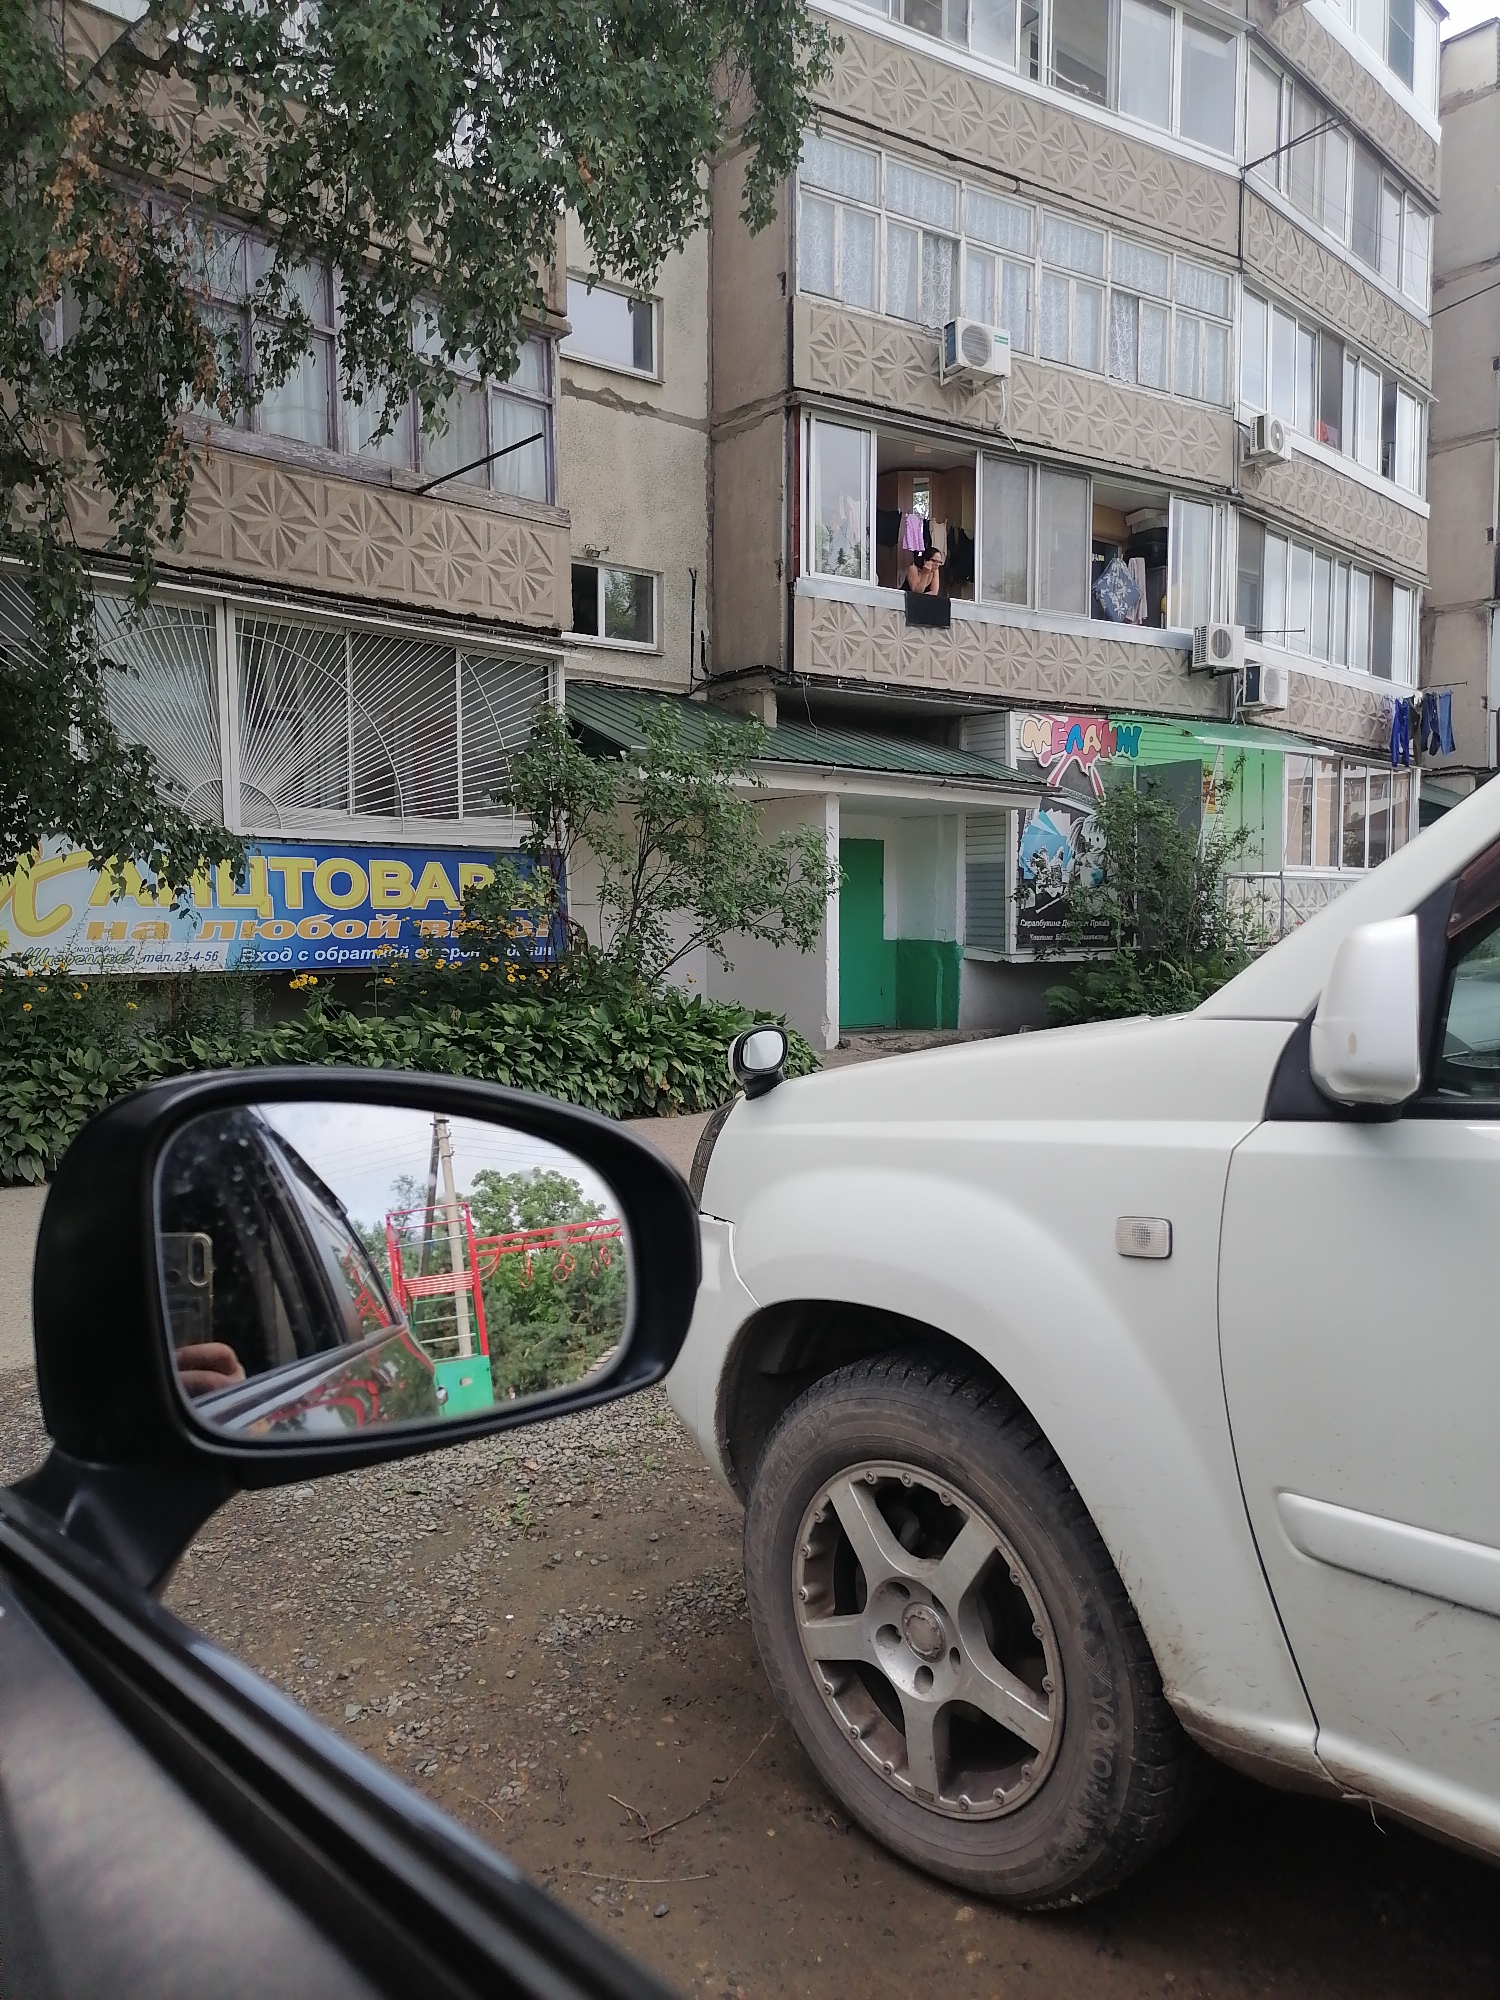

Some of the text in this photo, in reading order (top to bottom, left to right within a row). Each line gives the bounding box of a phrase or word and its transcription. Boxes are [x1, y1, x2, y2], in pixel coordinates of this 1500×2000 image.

[1023, 719, 1142, 758] МЕЛАНЖ
[0, 838, 552, 938] КАНЦТОВАР
[86, 921, 171, 941] на
[195, 913, 401, 941] любой
[240, 946, 293, 963] Вход
[298, 949, 309, 961] с
